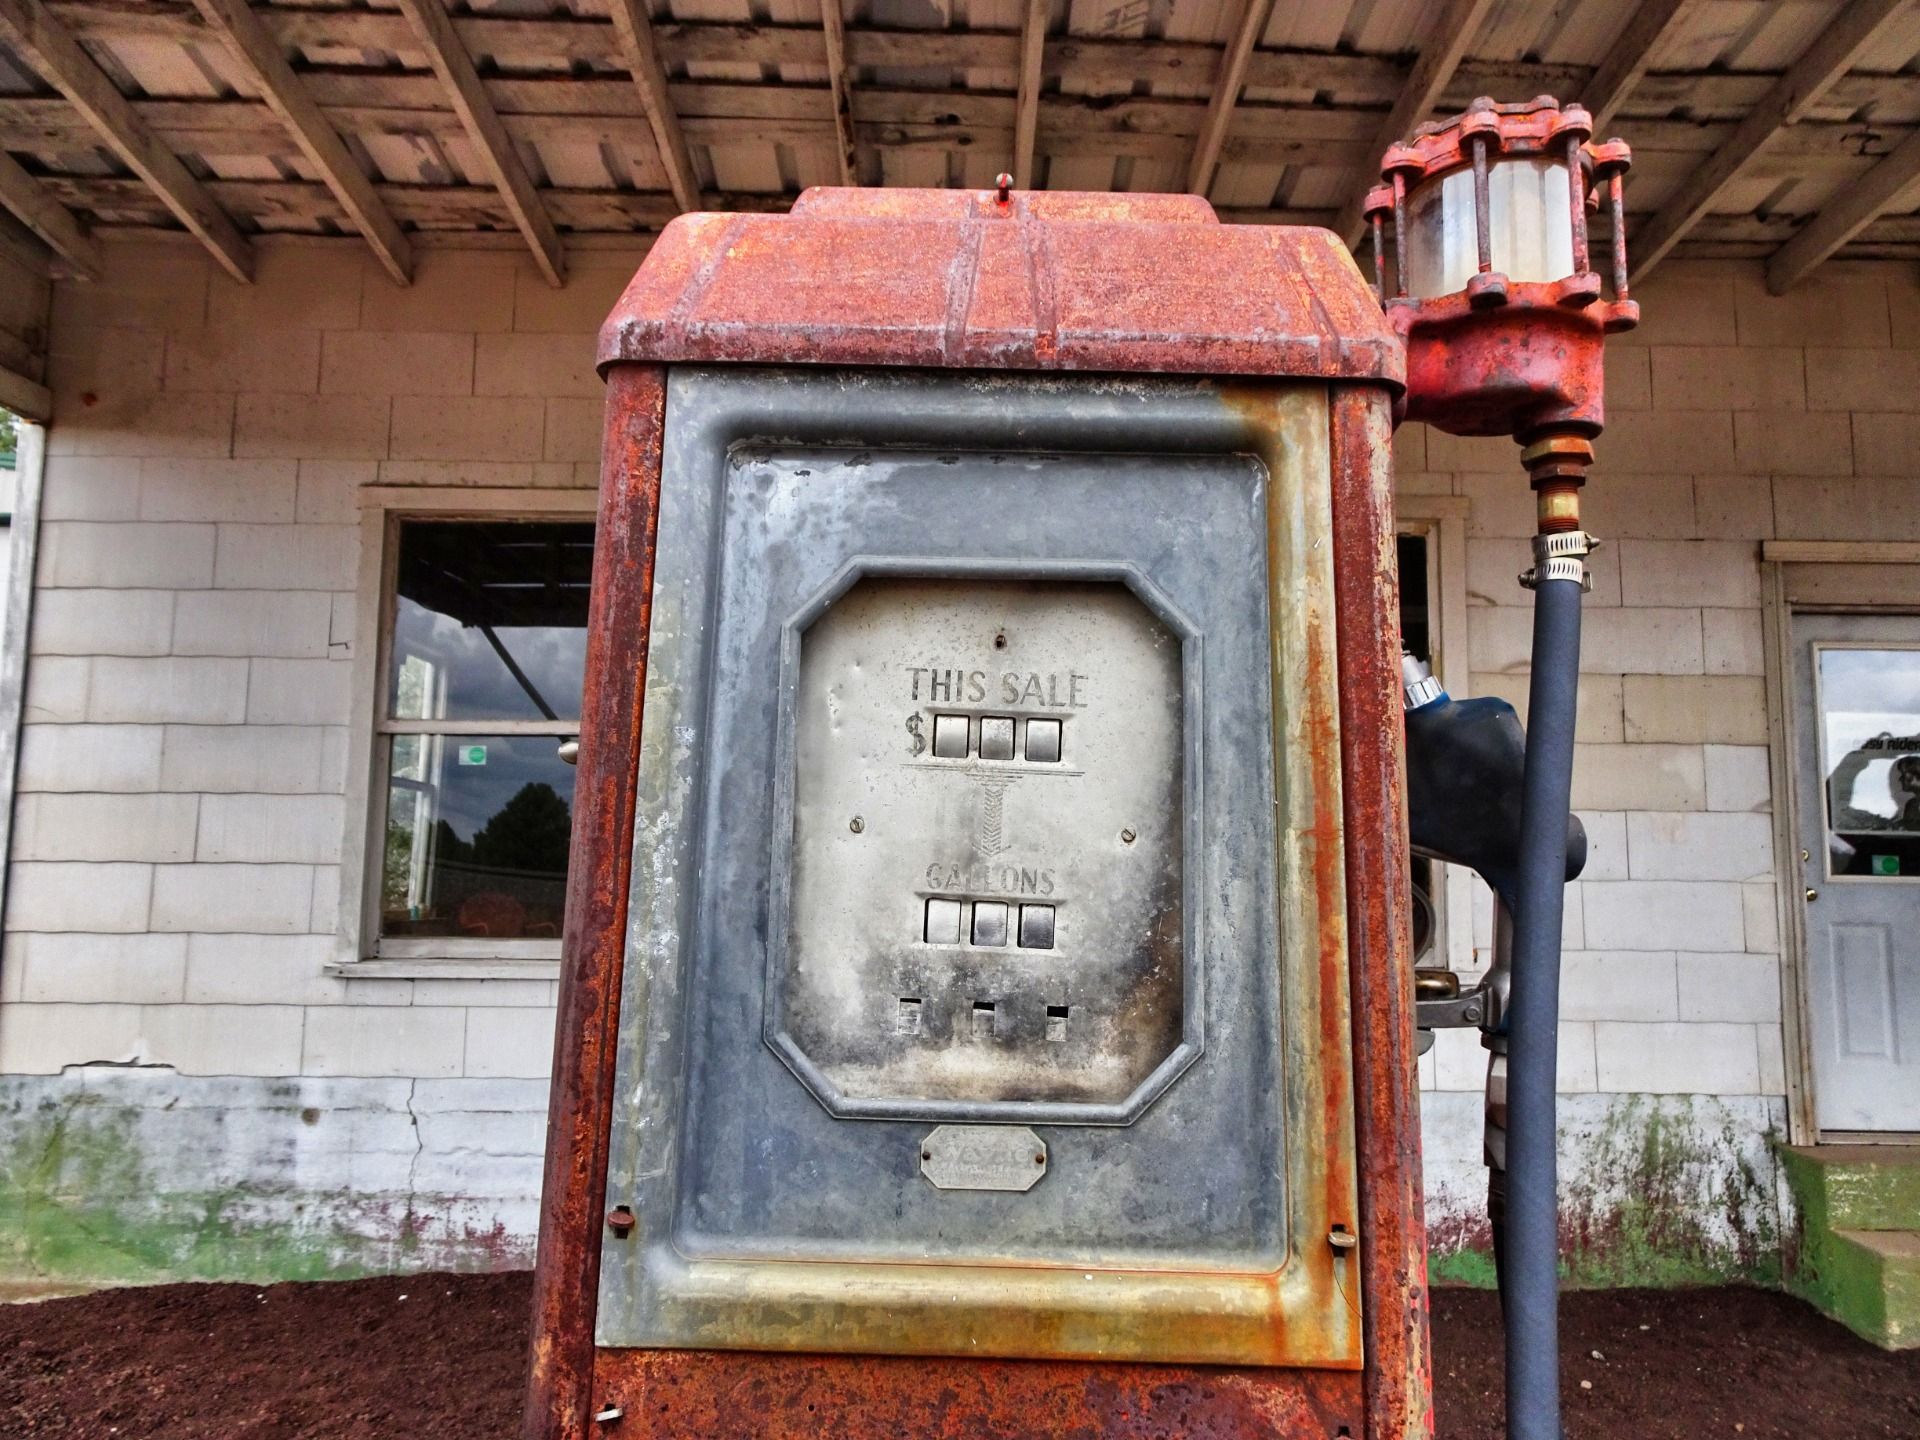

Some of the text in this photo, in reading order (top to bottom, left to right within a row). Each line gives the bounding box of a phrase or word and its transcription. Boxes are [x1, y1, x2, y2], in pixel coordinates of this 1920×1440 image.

[905, 668, 1089, 708] THIS SALE
[905, 711, 926, 757] $
